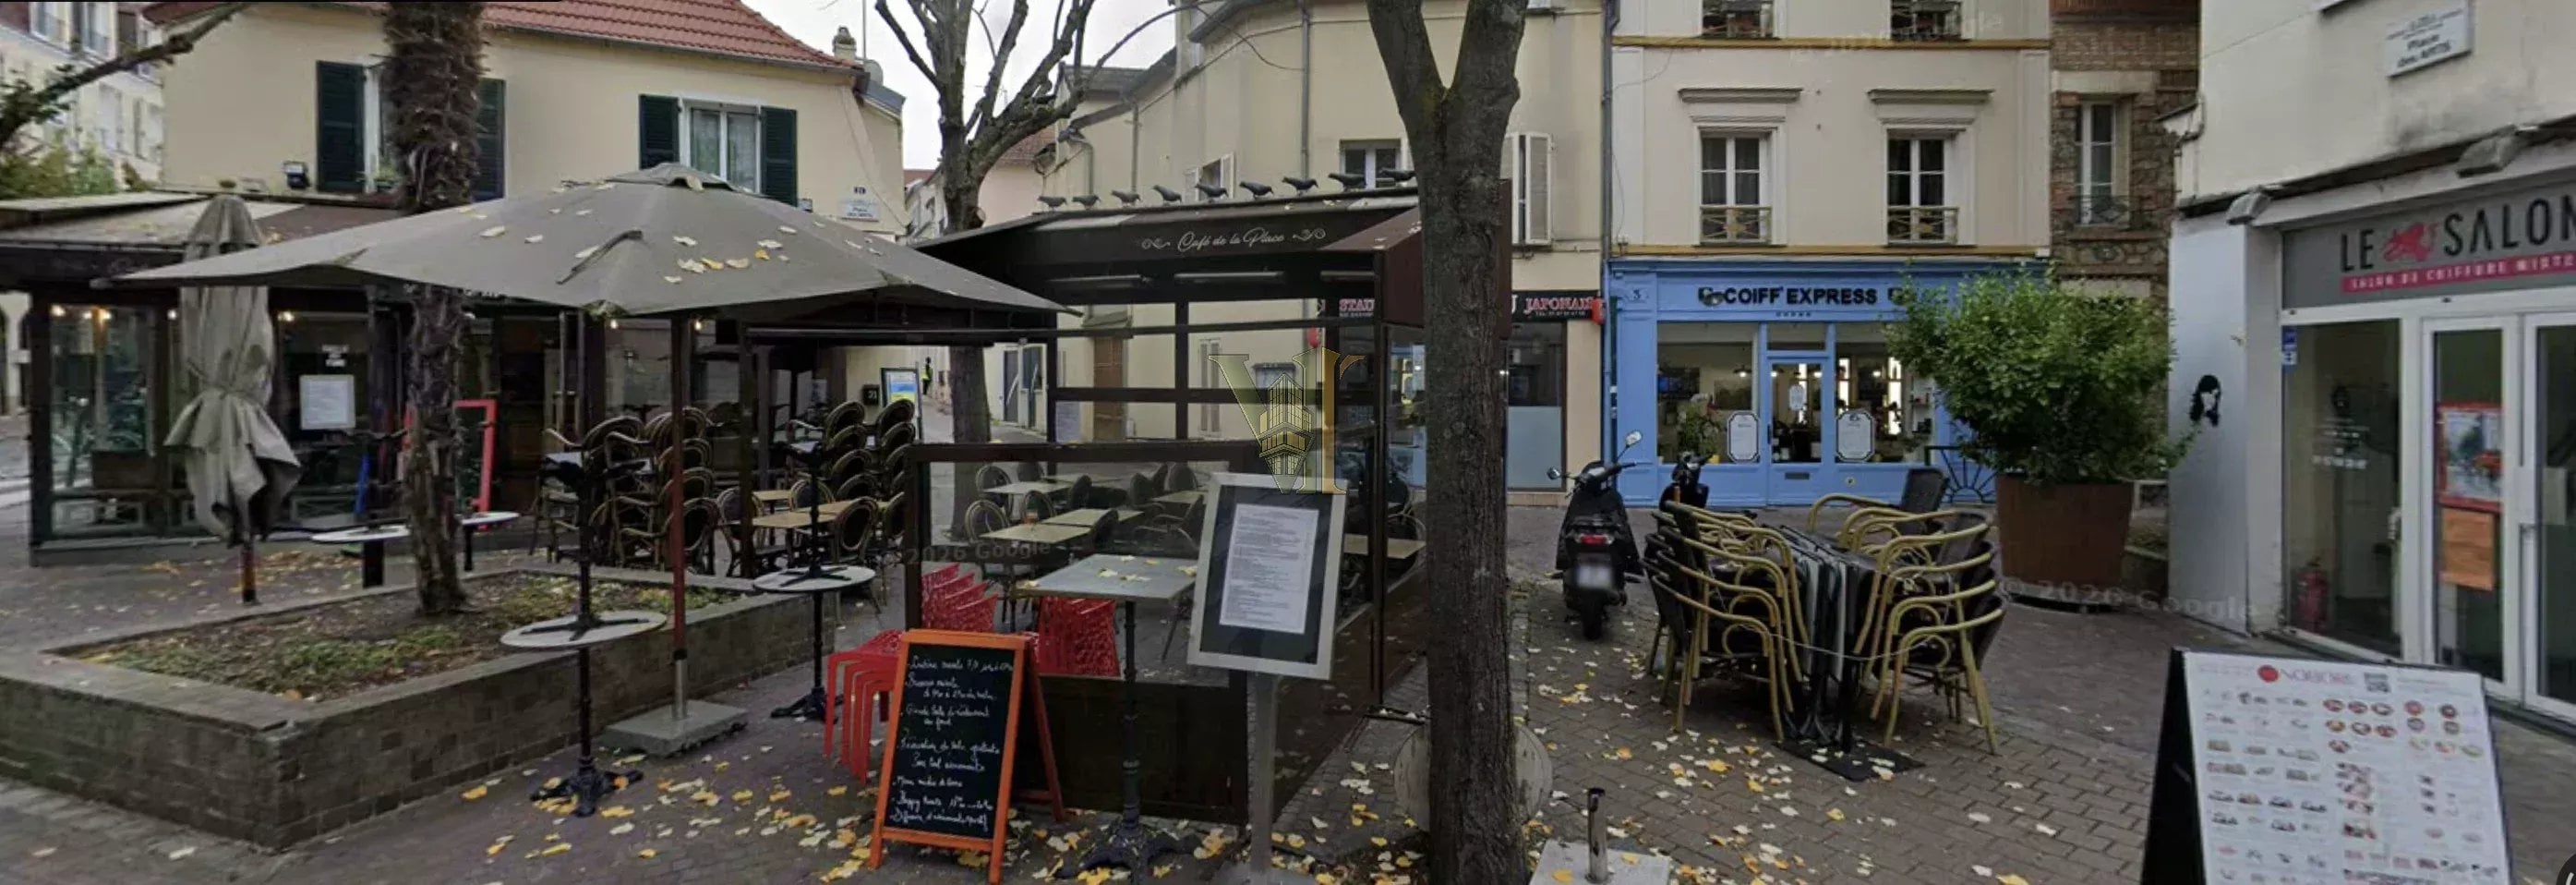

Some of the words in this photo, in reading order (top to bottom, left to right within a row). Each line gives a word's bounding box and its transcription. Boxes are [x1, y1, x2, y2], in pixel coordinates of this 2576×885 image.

[1178, 231, 1211, 252] Café
[1212, 236, 1226, 246] de
[1230, 233, 1241, 244] la
[1243, 226, 1284, 248] Place
[2341, 229, 2374, 272] LE
[1339, 298, 1375, 312] STAU
